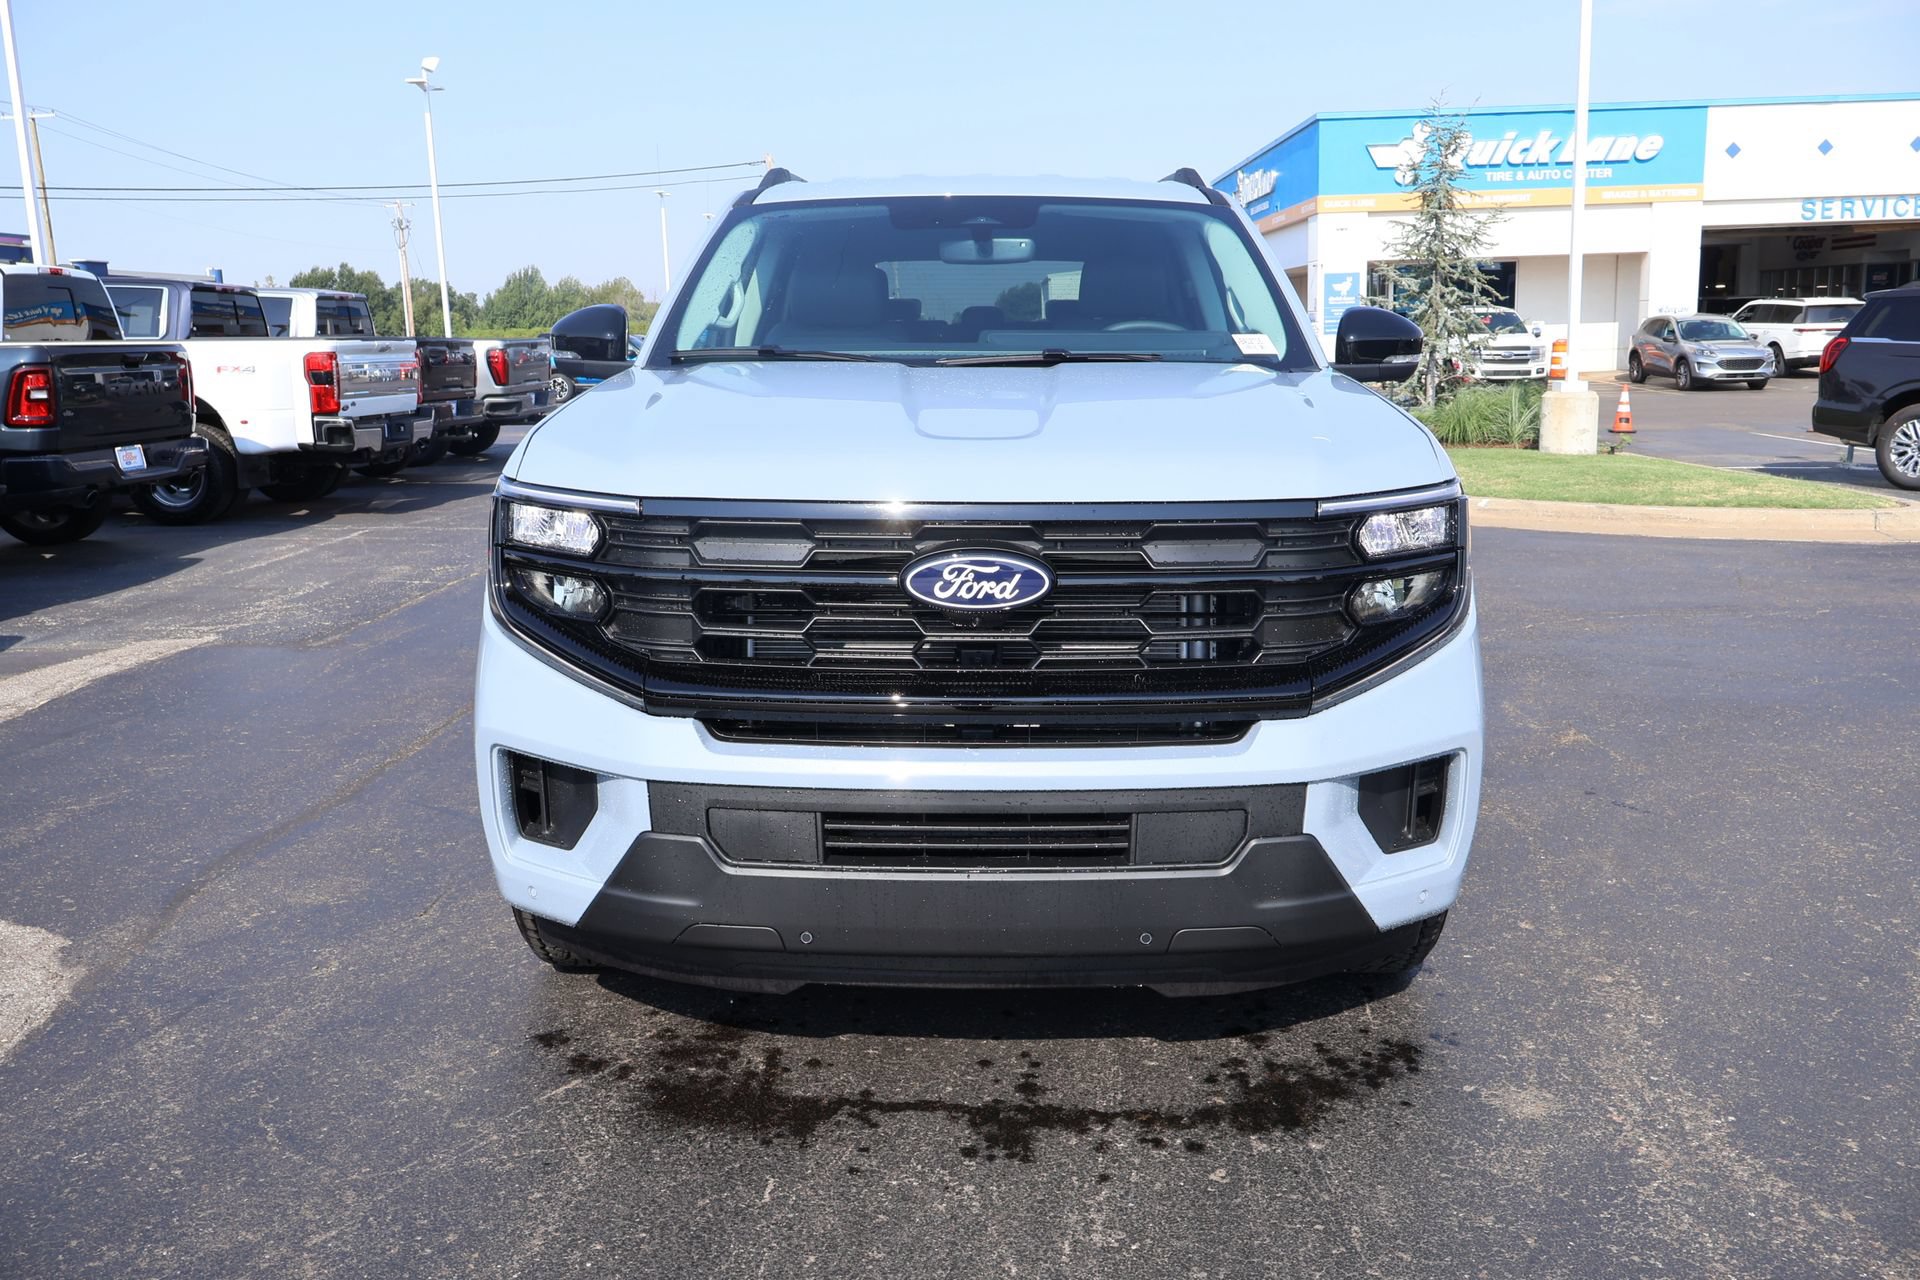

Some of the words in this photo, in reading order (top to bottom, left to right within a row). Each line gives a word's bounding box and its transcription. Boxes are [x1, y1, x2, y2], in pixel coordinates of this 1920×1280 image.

[1485, 171, 1513, 182] TIRE
[1515, 170, 1525, 181] &
[1527, 169, 1561, 181] AUTO
[1562, 168, 1613, 180] CTER
[933, 563, 1022, 600] Ford
